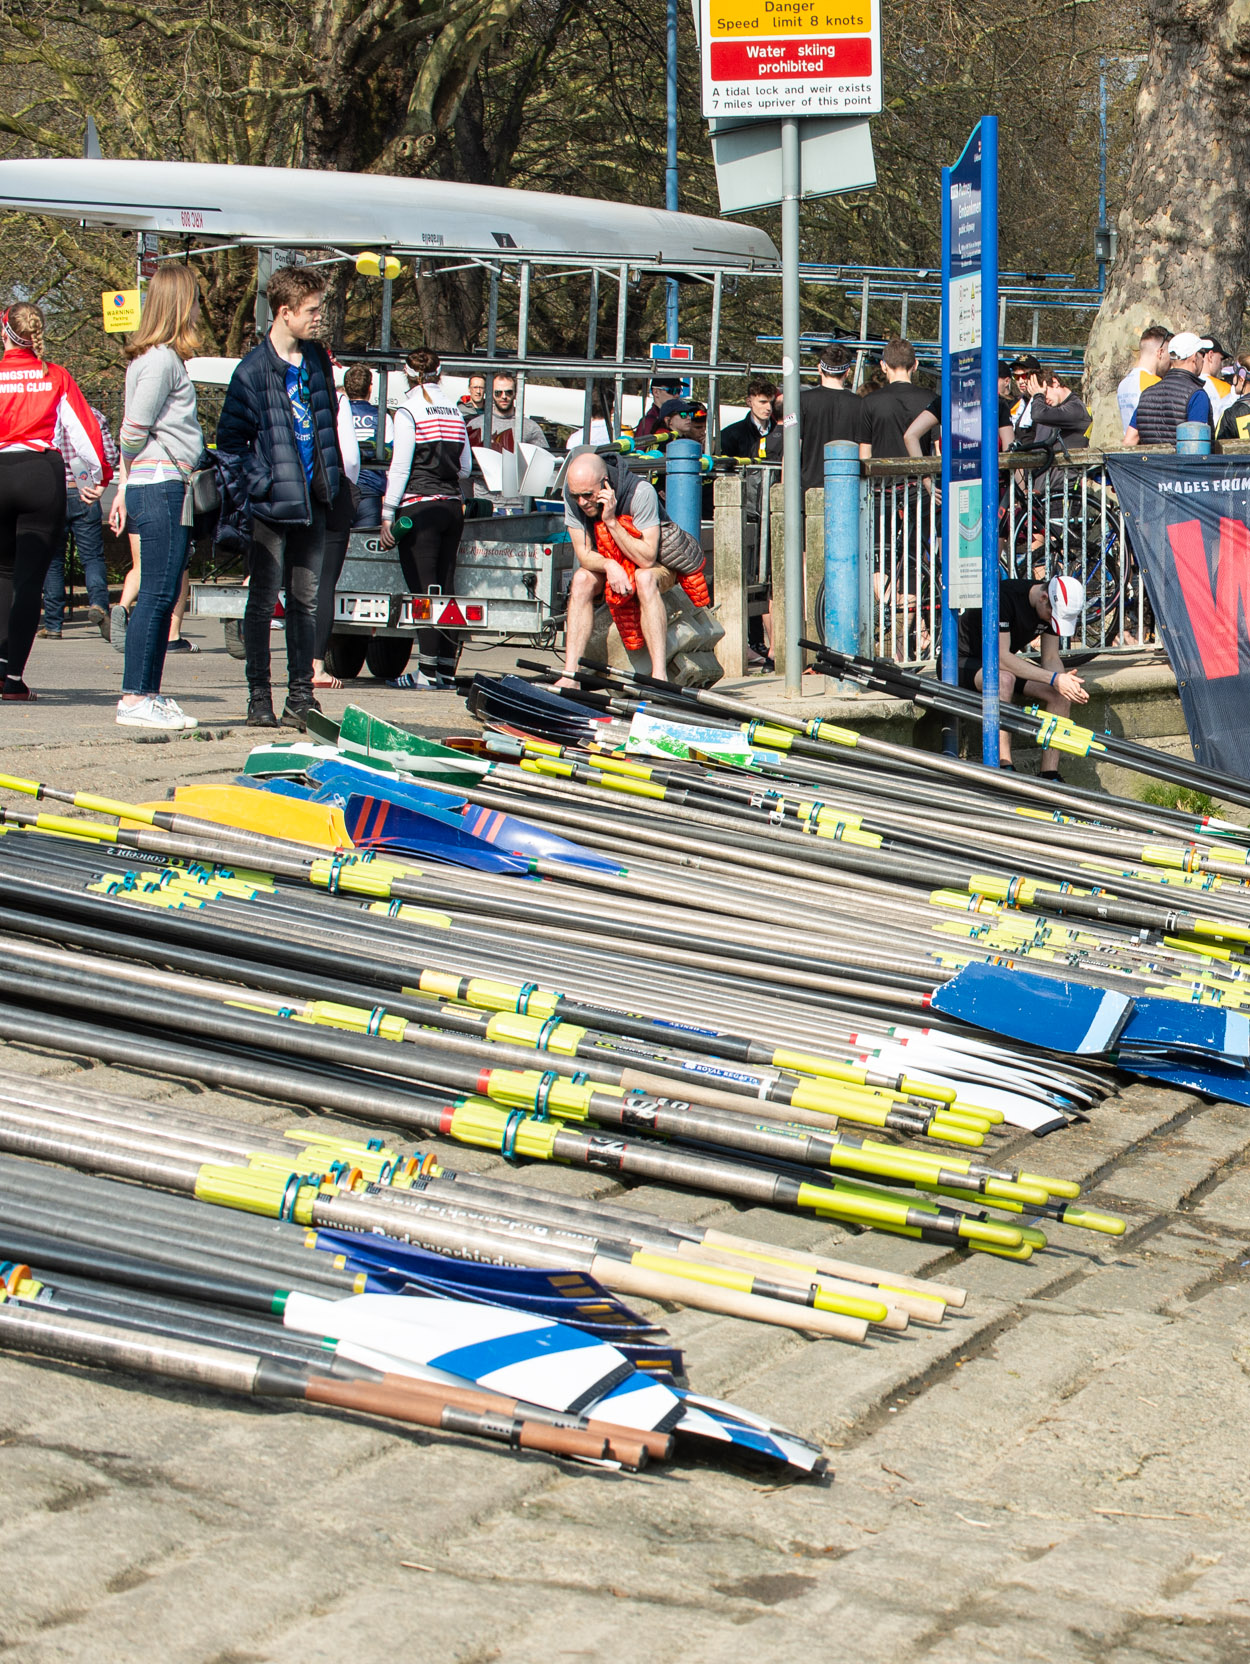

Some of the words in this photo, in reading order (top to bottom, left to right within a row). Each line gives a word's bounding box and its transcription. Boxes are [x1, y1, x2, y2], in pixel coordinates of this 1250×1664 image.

[765, 1, 815, 13] Danger
[717, 18, 760, 31] Speed
[773, 16, 804, 28] limit
[810, 15, 819, 26] 8
[826, 15, 864, 26] knots
[746, 45, 786, 58] Water
[797, 43, 836, 58] skiing
[758, 59, 824, 76] prohibited
[712, 87, 720, 97] A
[725, 86, 750, 96] tidal
[755, 85, 779, 95] lock
[784, 84, 804, 94] and
[809, 83, 832, 94] weir
[838, 82, 872, 93] exists
[712, 99, 719, 109] 7
[723, 98, 753, 109] miles
[758, 98, 796, 109] upriver
[801, 96, 812, 106] of
[817, 95, 839, 106] this
[844, 95, 872, 107] point
[421, 232, 444, 247] Mirabella
[106, 308, 135, 317] WARNING
[0, 369, 44, 381] INGSTON
[26, 382, 52, 392] CLUB
[426, 406, 452, 416] KINGSTON
[353, 415, 373, 428] RC
[1158, 481, 1210, 494] IMAGES
[696, 1064, 722, 1076] ROYAL
